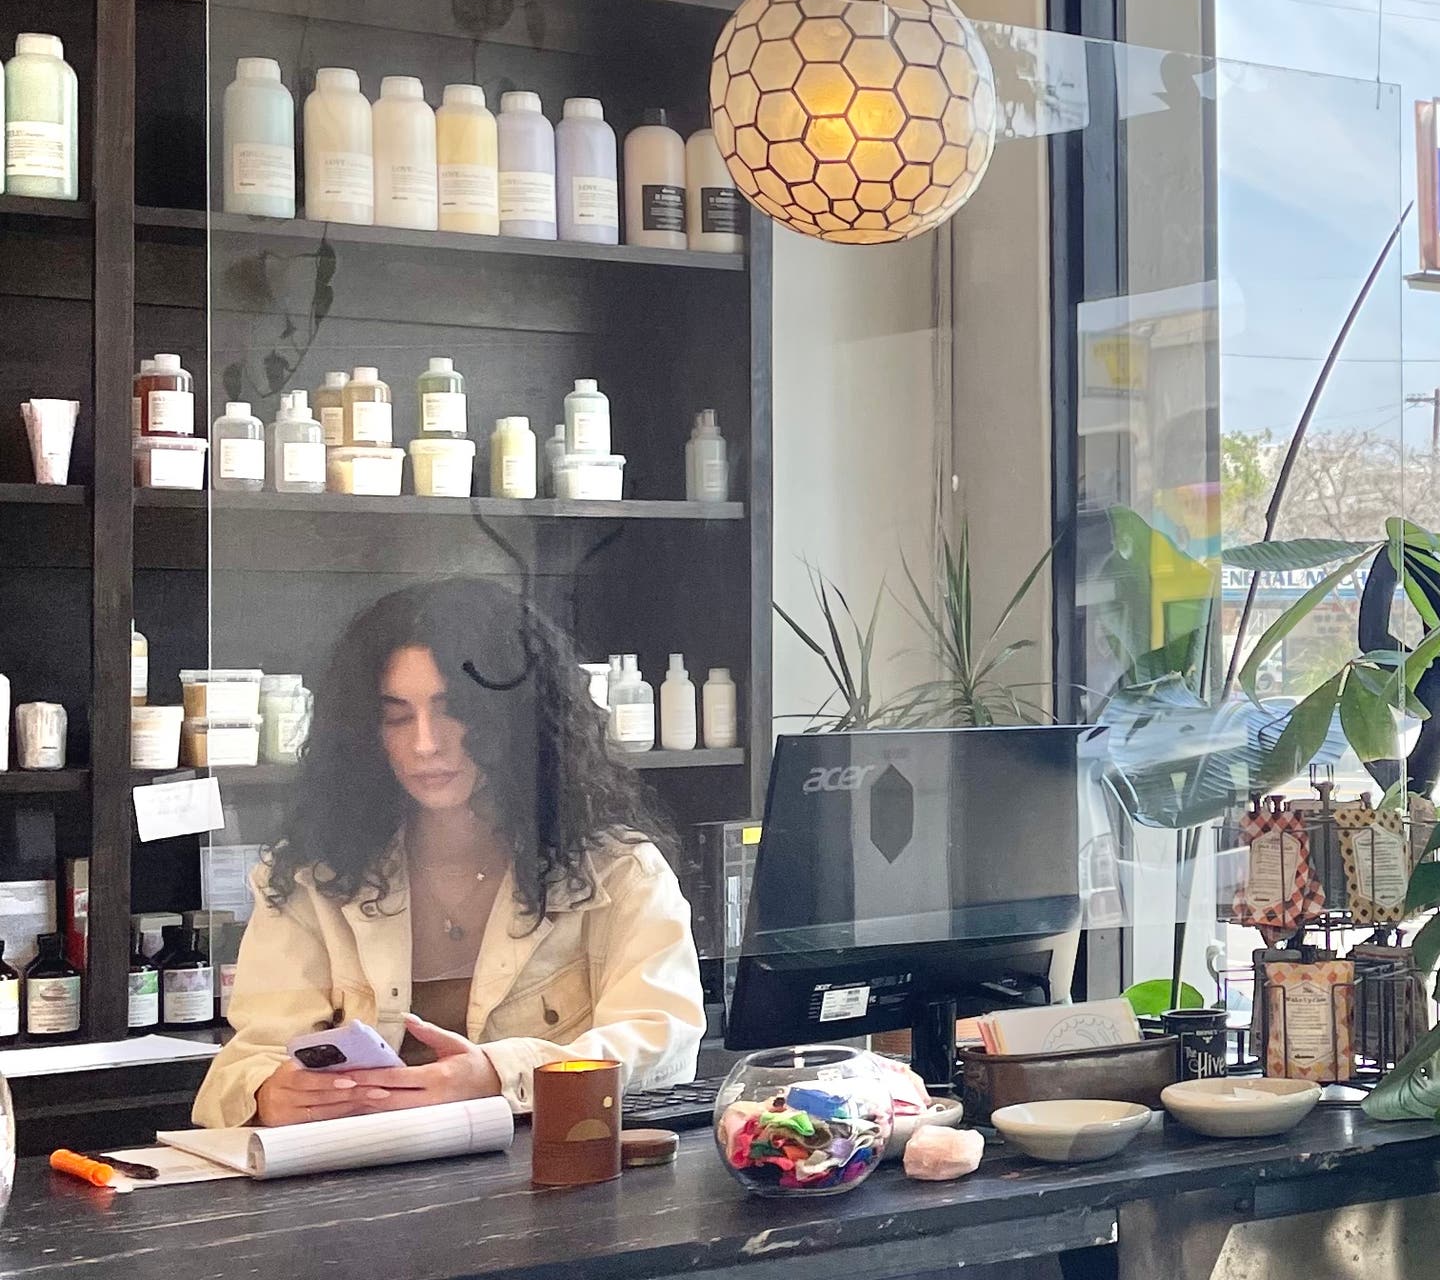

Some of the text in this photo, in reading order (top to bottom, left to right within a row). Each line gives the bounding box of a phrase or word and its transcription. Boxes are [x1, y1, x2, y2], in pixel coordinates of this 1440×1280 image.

[1222, 570, 1299, 586] ENERAL
[802, 765, 876, 795] acer
[1188, 1051, 1226, 1079] Hive
